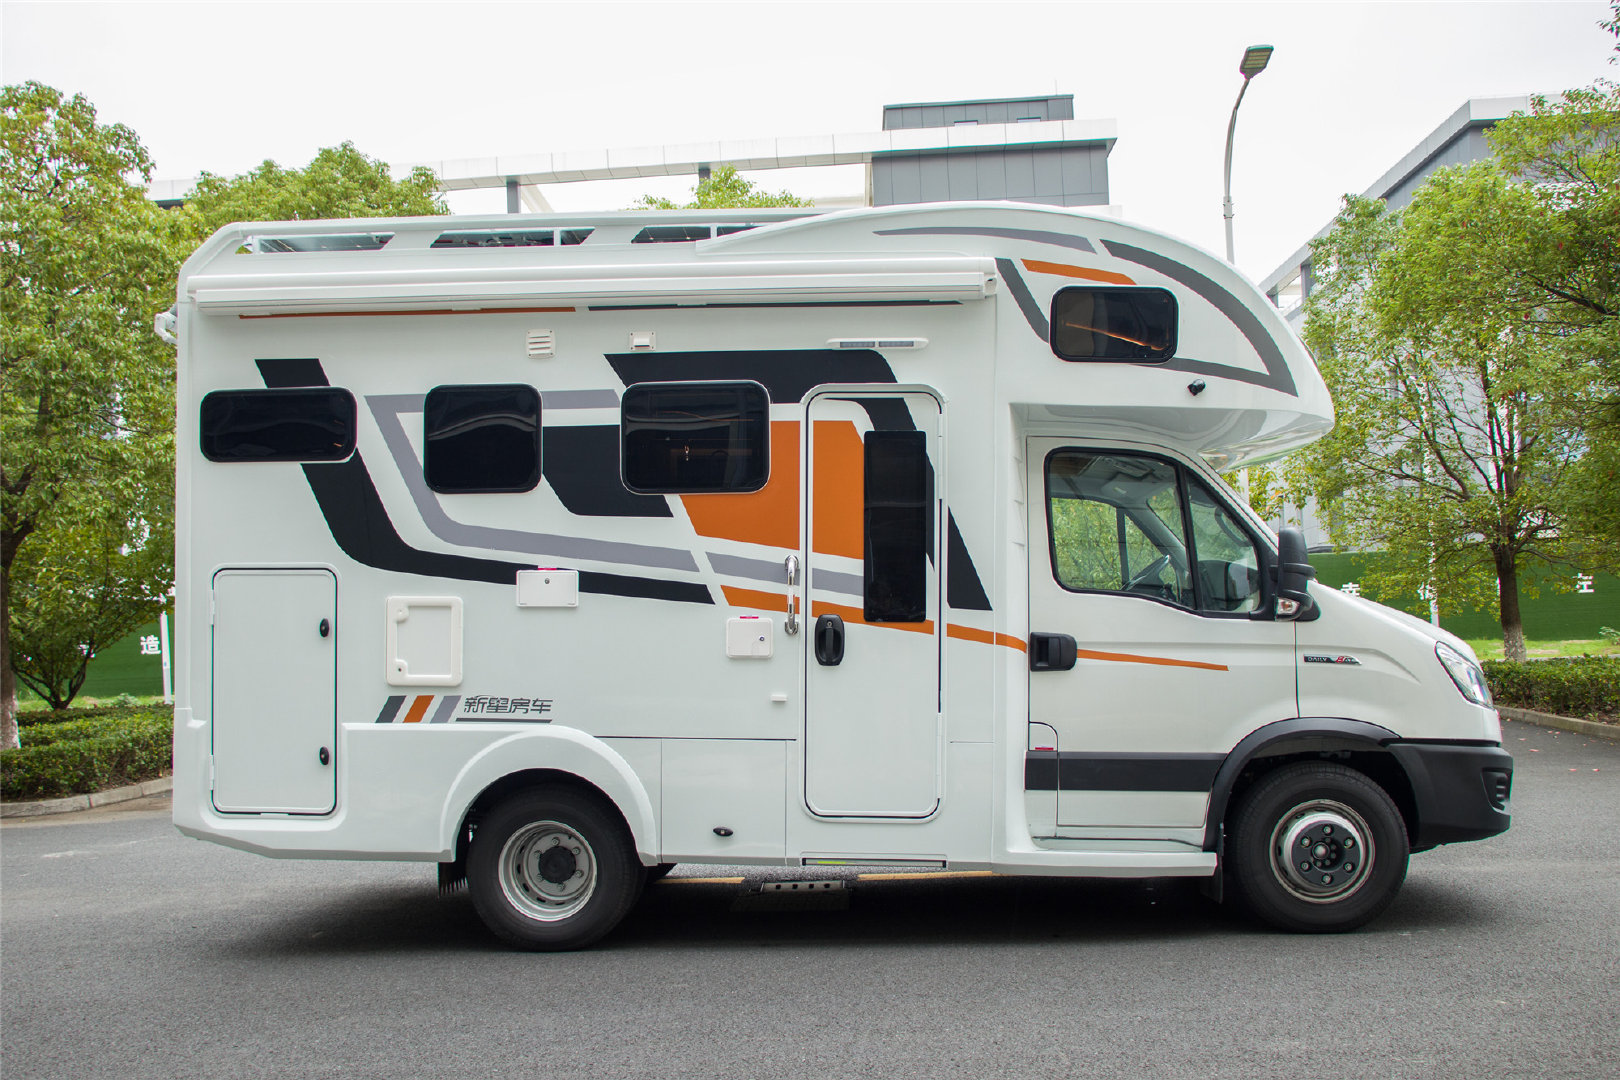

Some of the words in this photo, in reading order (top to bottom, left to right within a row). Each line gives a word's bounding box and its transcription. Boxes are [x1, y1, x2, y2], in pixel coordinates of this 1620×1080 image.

[140, 634, 161, 655] 造
[464, 695, 553, 714] 新星房车
